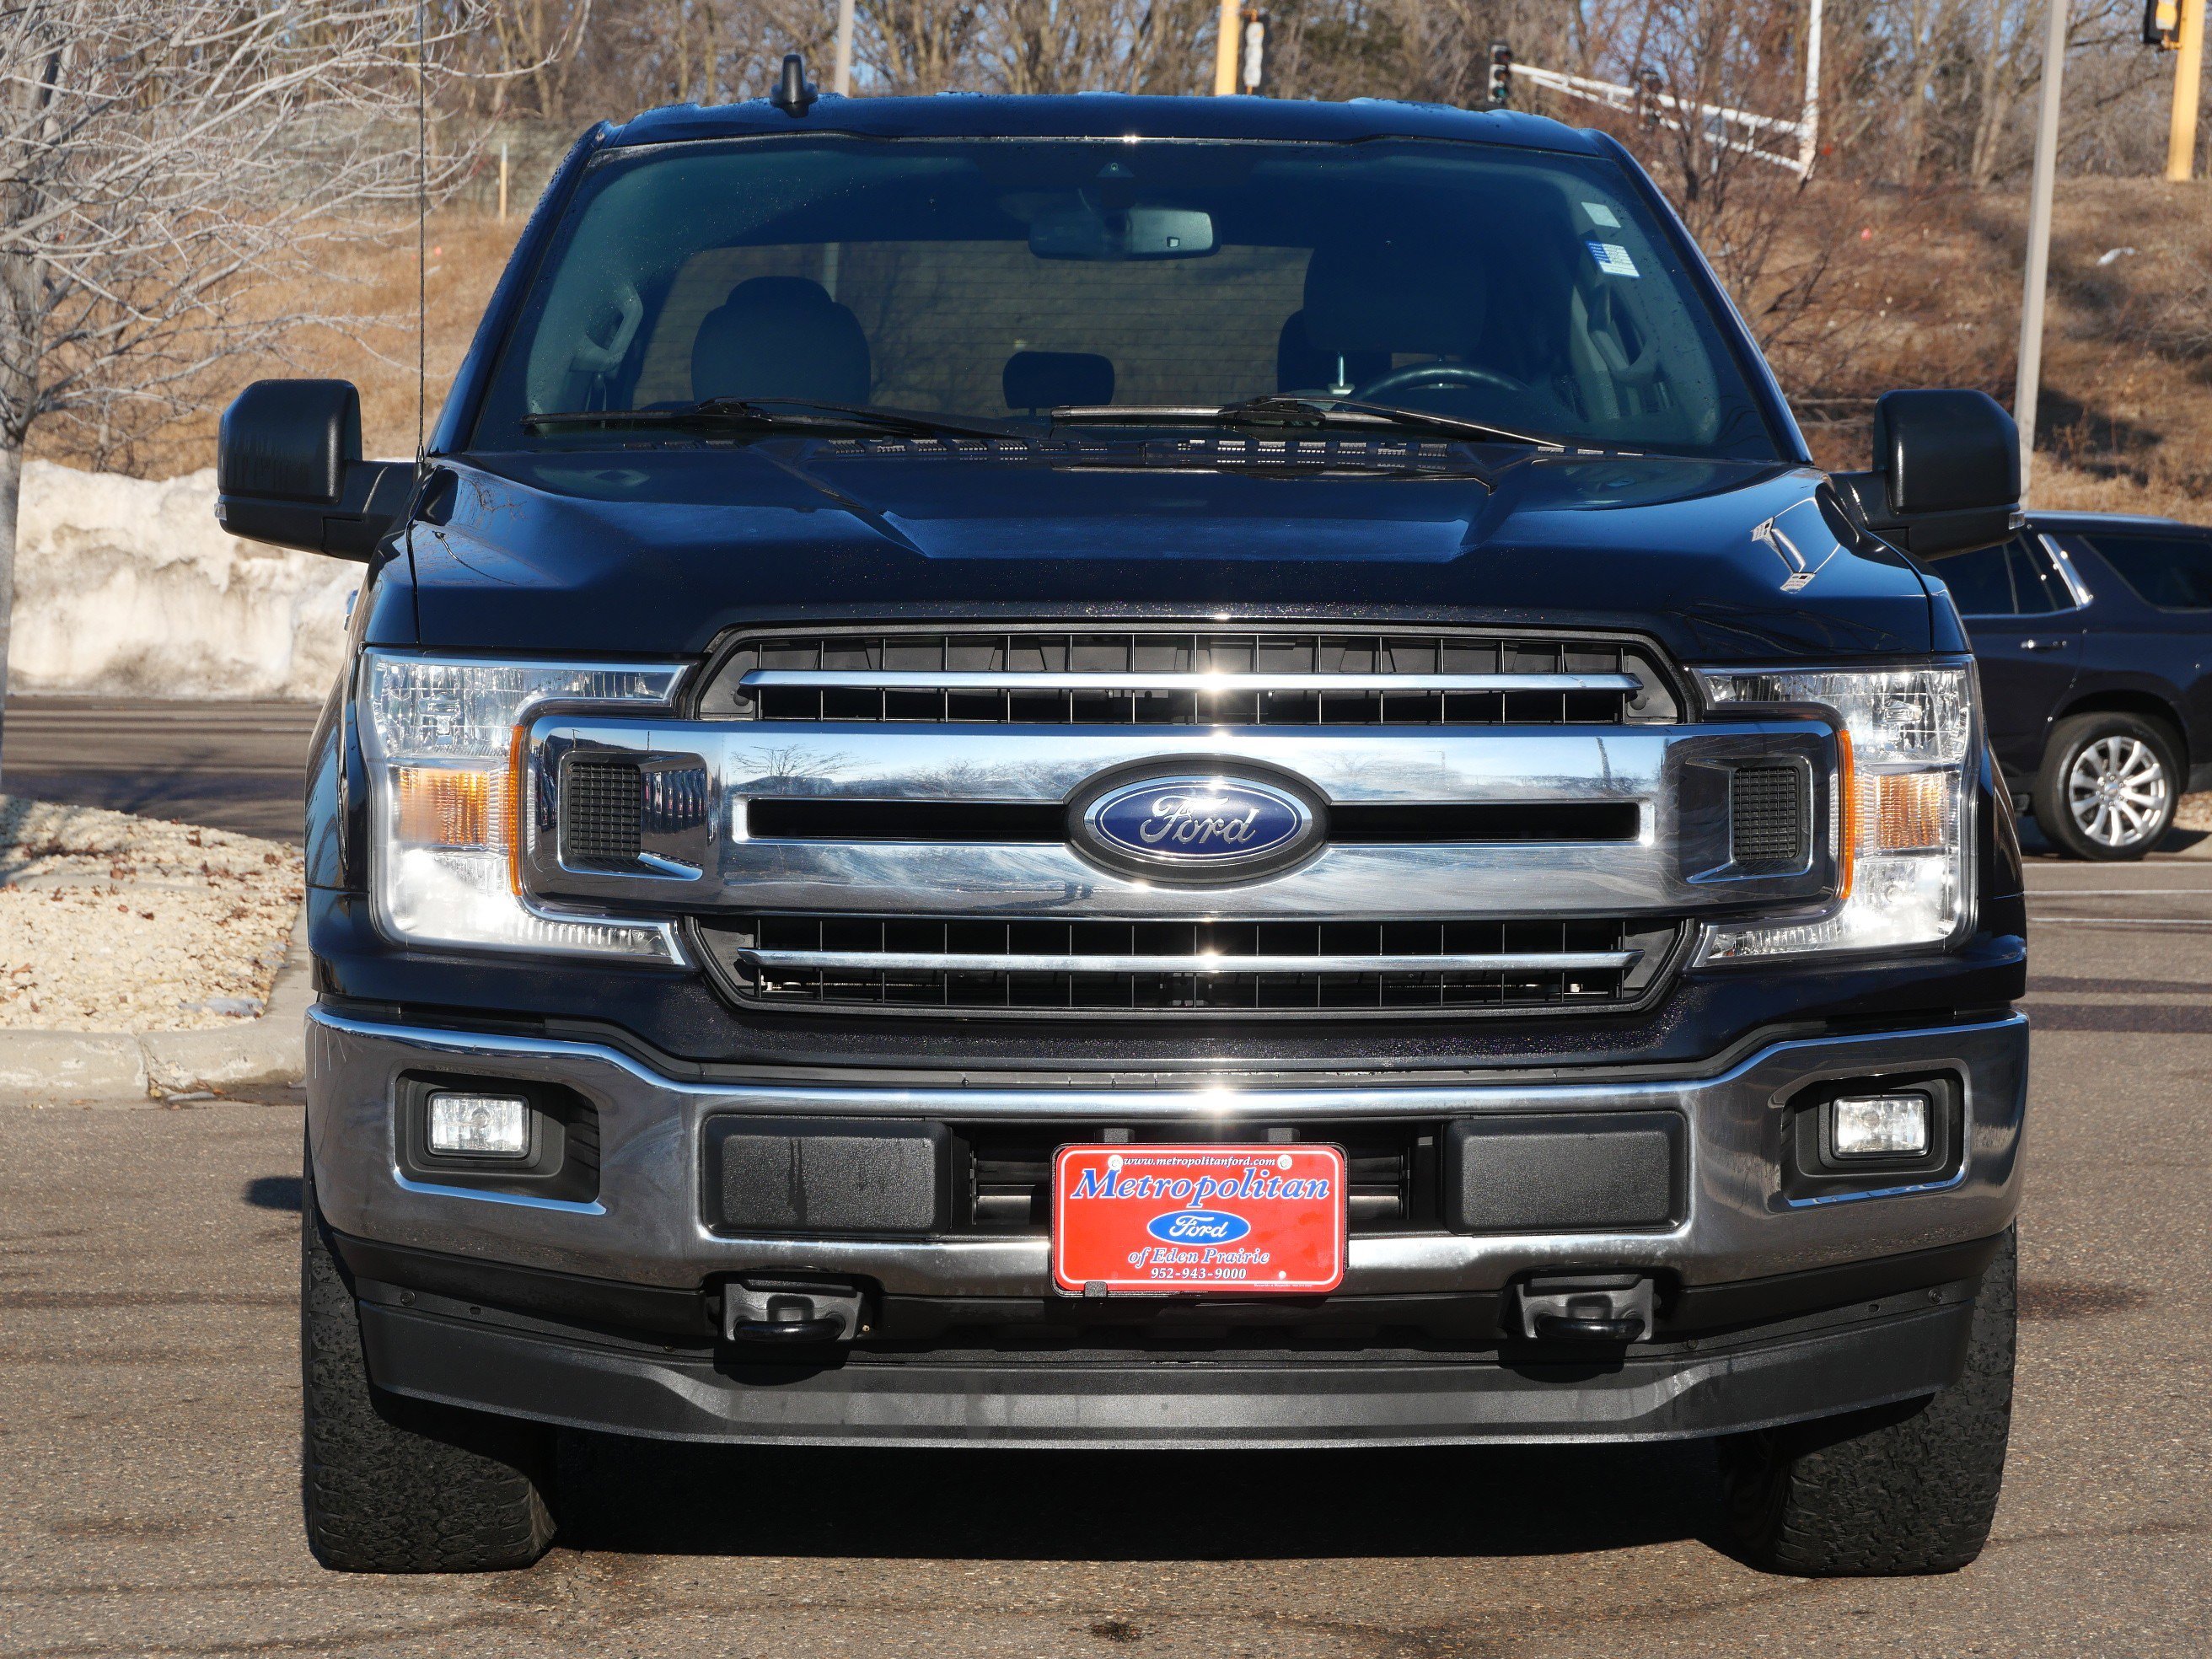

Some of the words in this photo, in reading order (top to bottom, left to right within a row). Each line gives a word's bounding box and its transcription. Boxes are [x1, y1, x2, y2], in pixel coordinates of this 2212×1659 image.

[1140, 795, 1259, 844] Ford
[1123, 1156, 1275, 1168] www.metropolitanford.com
[1070, 1167, 1329, 1208] Metropolitan
[1169, 1215, 1229, 1238] Ford
[1128, 1247, 1152, 1269] of
[1150, 1247, 1199, 1264] Eden
[1203, 1248, 1270, 1264] Prairie
[1151, 1268, 1247, 1279] 952-943-9000
